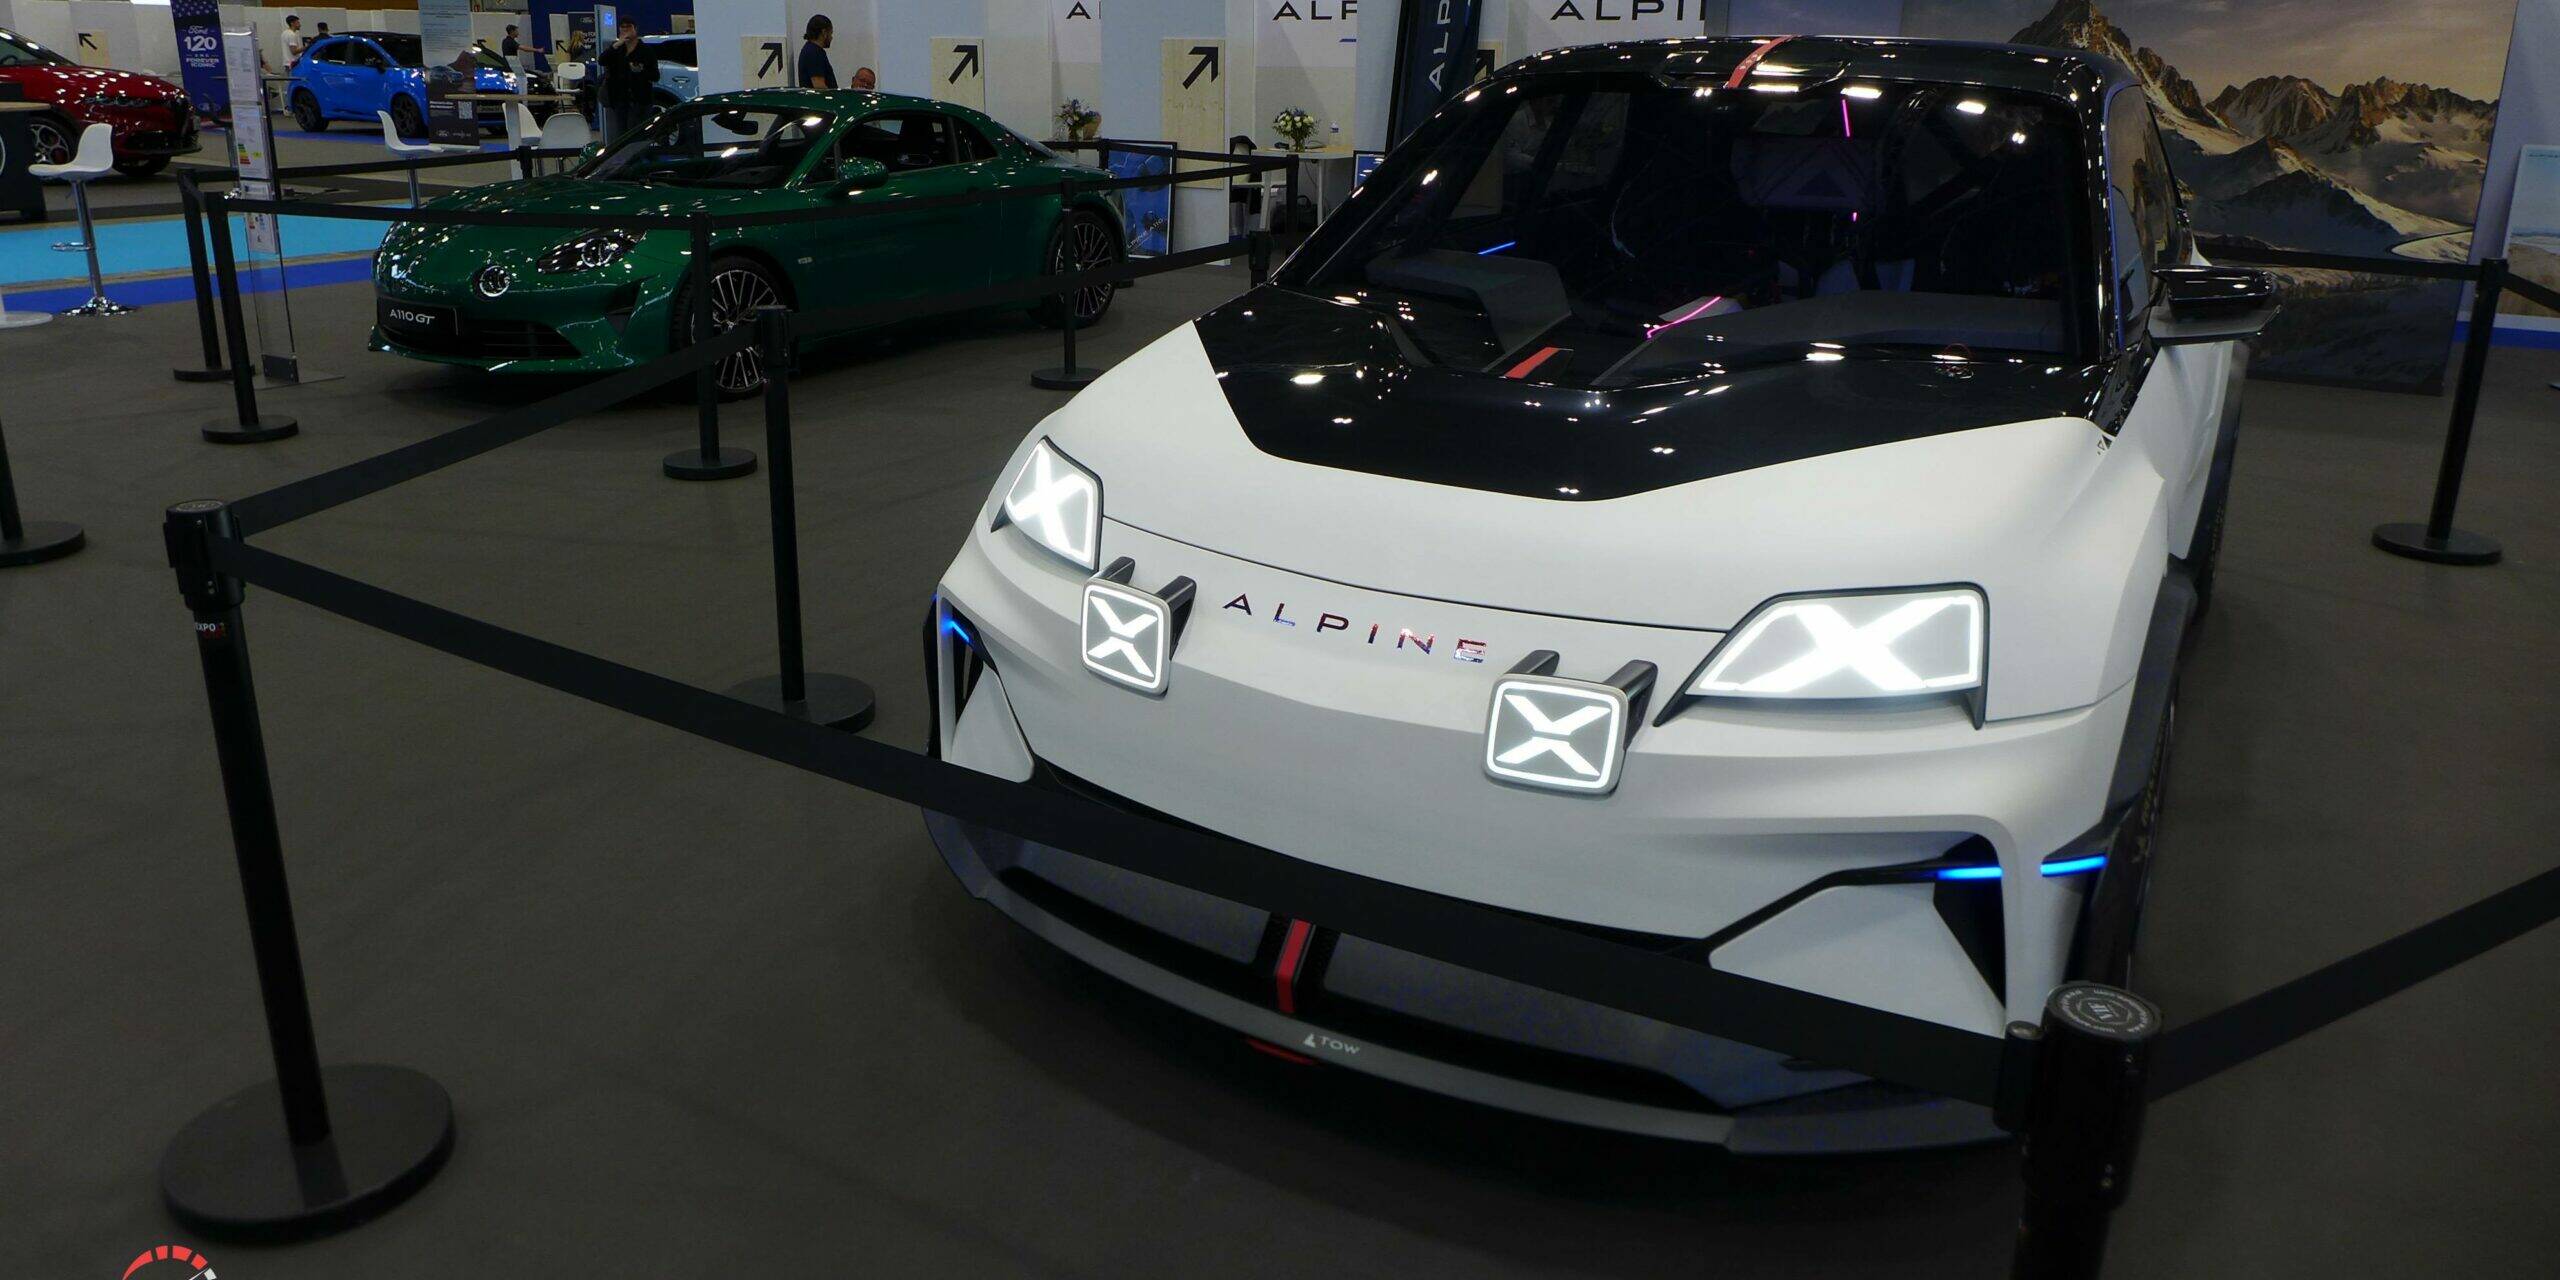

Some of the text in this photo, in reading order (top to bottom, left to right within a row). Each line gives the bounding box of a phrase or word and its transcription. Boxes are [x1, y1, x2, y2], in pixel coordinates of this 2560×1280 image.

[1550, 0, 1706, 21] ALPI
[184, 35, 217, 51] 120
[389, 309, 436, 325] A110 GT
[1222, 593, 1488, 665] ALPINE
[1319, 1035, 1360, 1055] TOW
